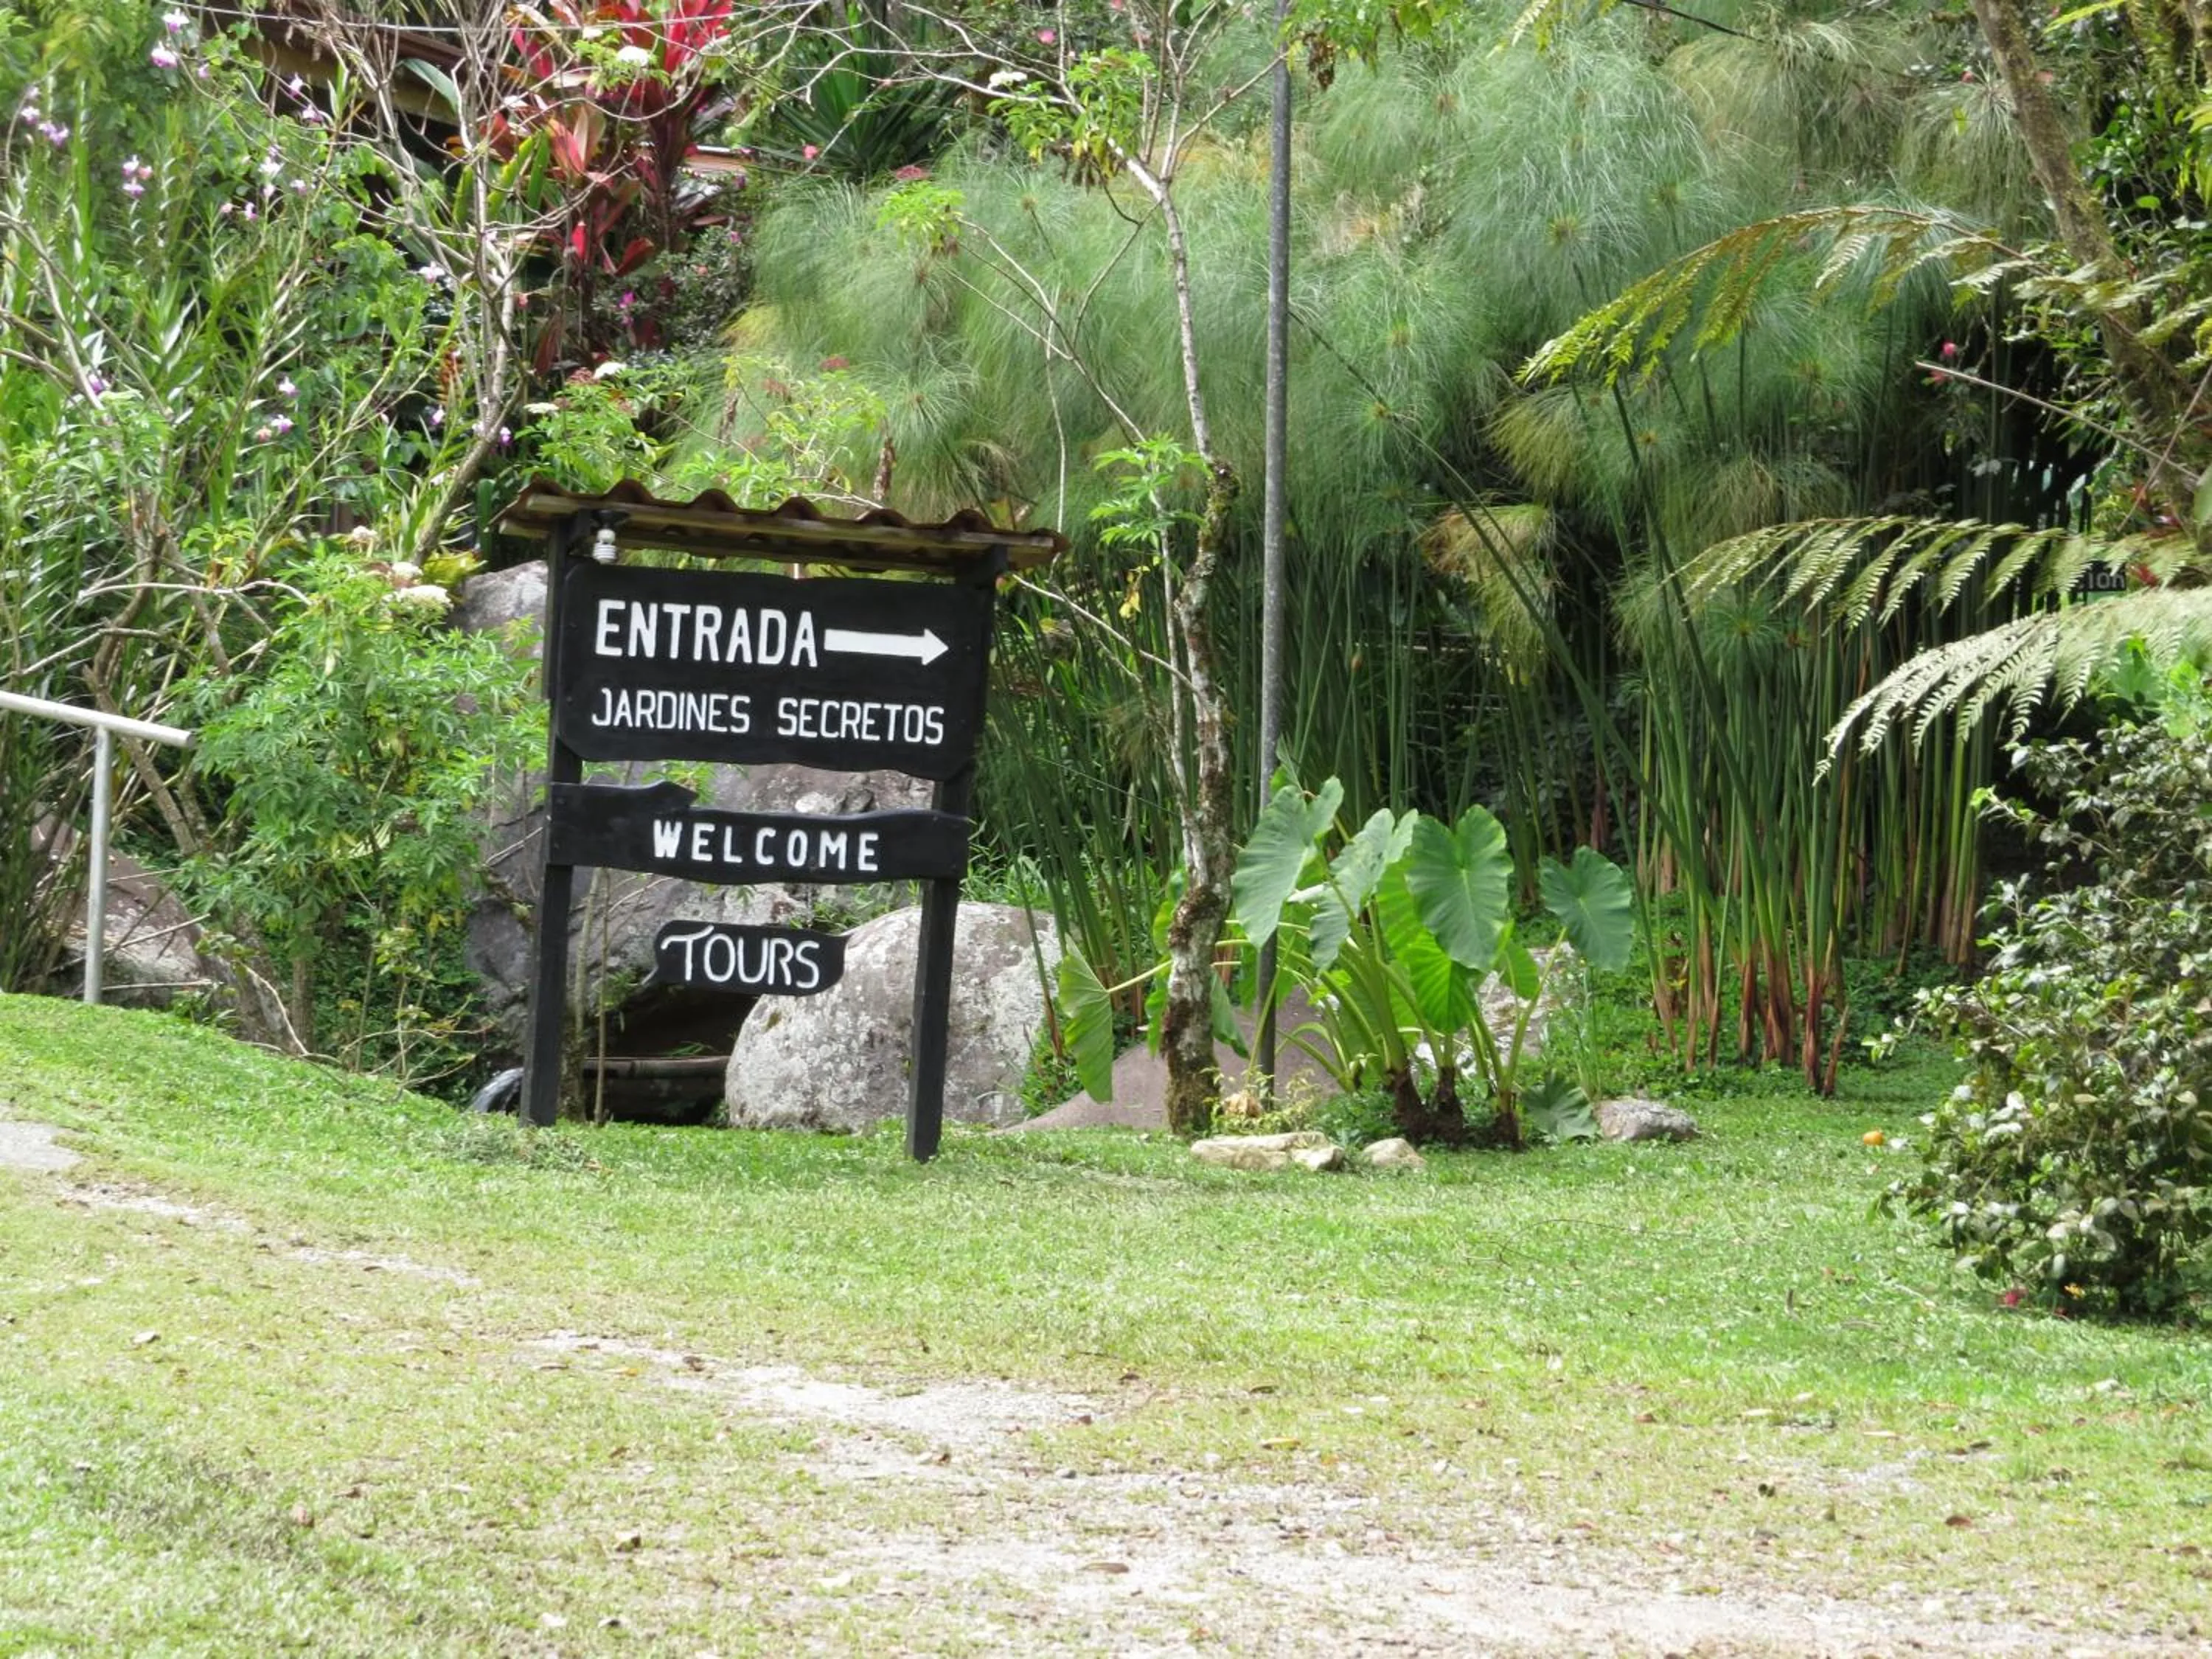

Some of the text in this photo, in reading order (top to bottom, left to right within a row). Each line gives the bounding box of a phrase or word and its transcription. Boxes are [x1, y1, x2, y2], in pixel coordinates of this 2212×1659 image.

[595, 599, 818, 668] ENTRADA
[591, 687, 945, 745] JARDINES SECRETOS
[653, 819, 880, 872] WELCOME
[661, 925, 821, 990] TOURS
